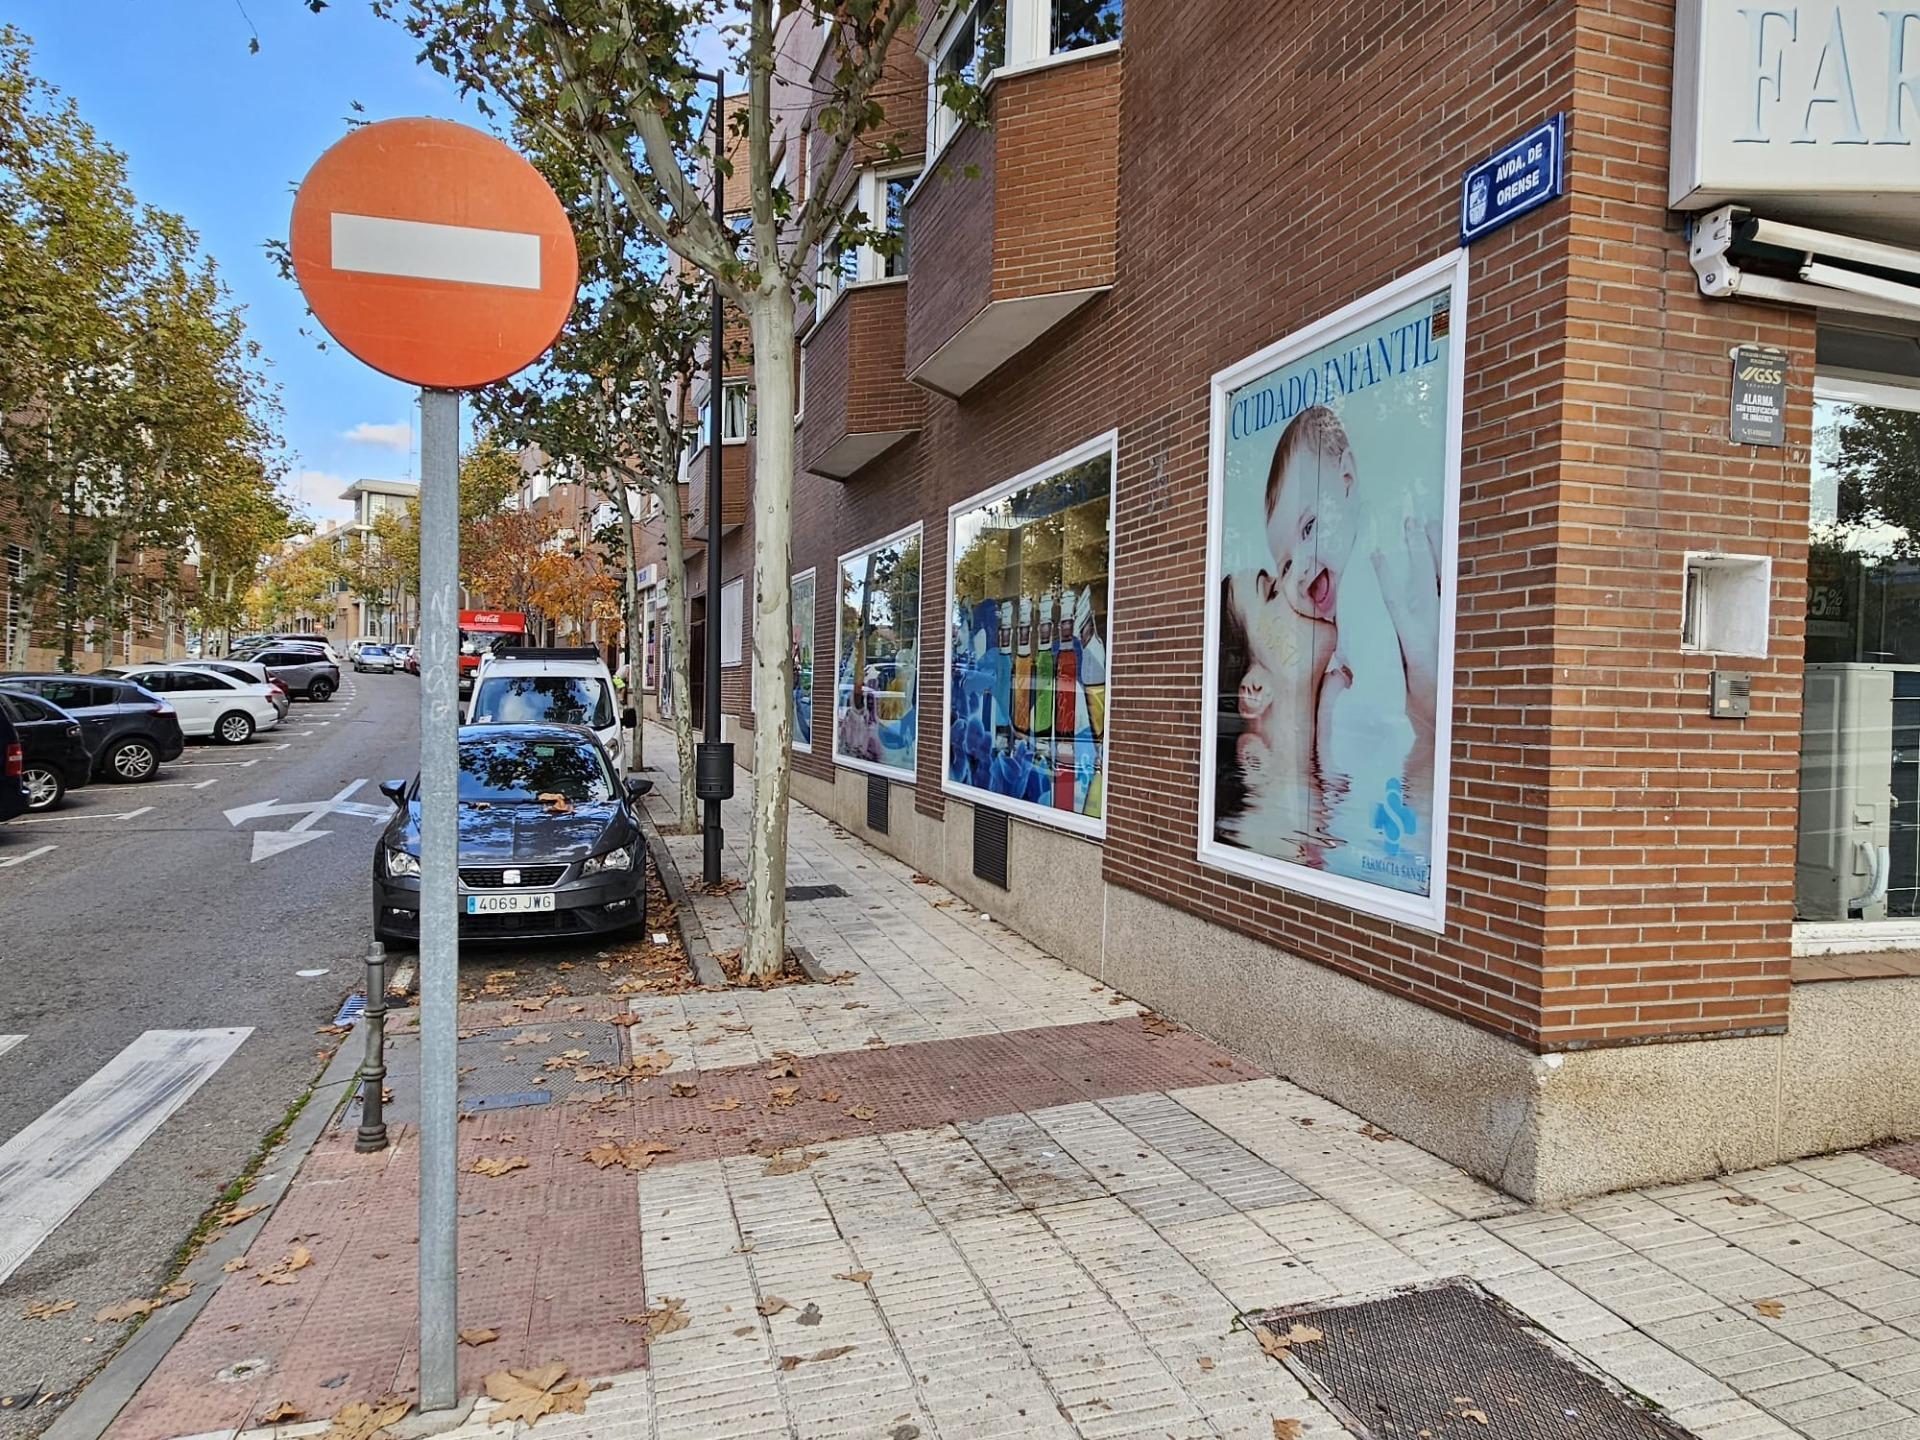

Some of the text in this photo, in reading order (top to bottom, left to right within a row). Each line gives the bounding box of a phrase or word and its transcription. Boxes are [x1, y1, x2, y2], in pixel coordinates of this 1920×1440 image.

[1495, 142, 1543, 183] AVDA. DE
[1496, 169, 1541, 206] ORENSE
[1231, 367, 1318, 440] CUIDADO
[1323, 315, 1439, 403] INFANTIL
[1753, 367, 1782, 385] GSS
[1742, 393, 1774, 407] ALARMA
[479, 896, 551, 910] 4069 JWG
